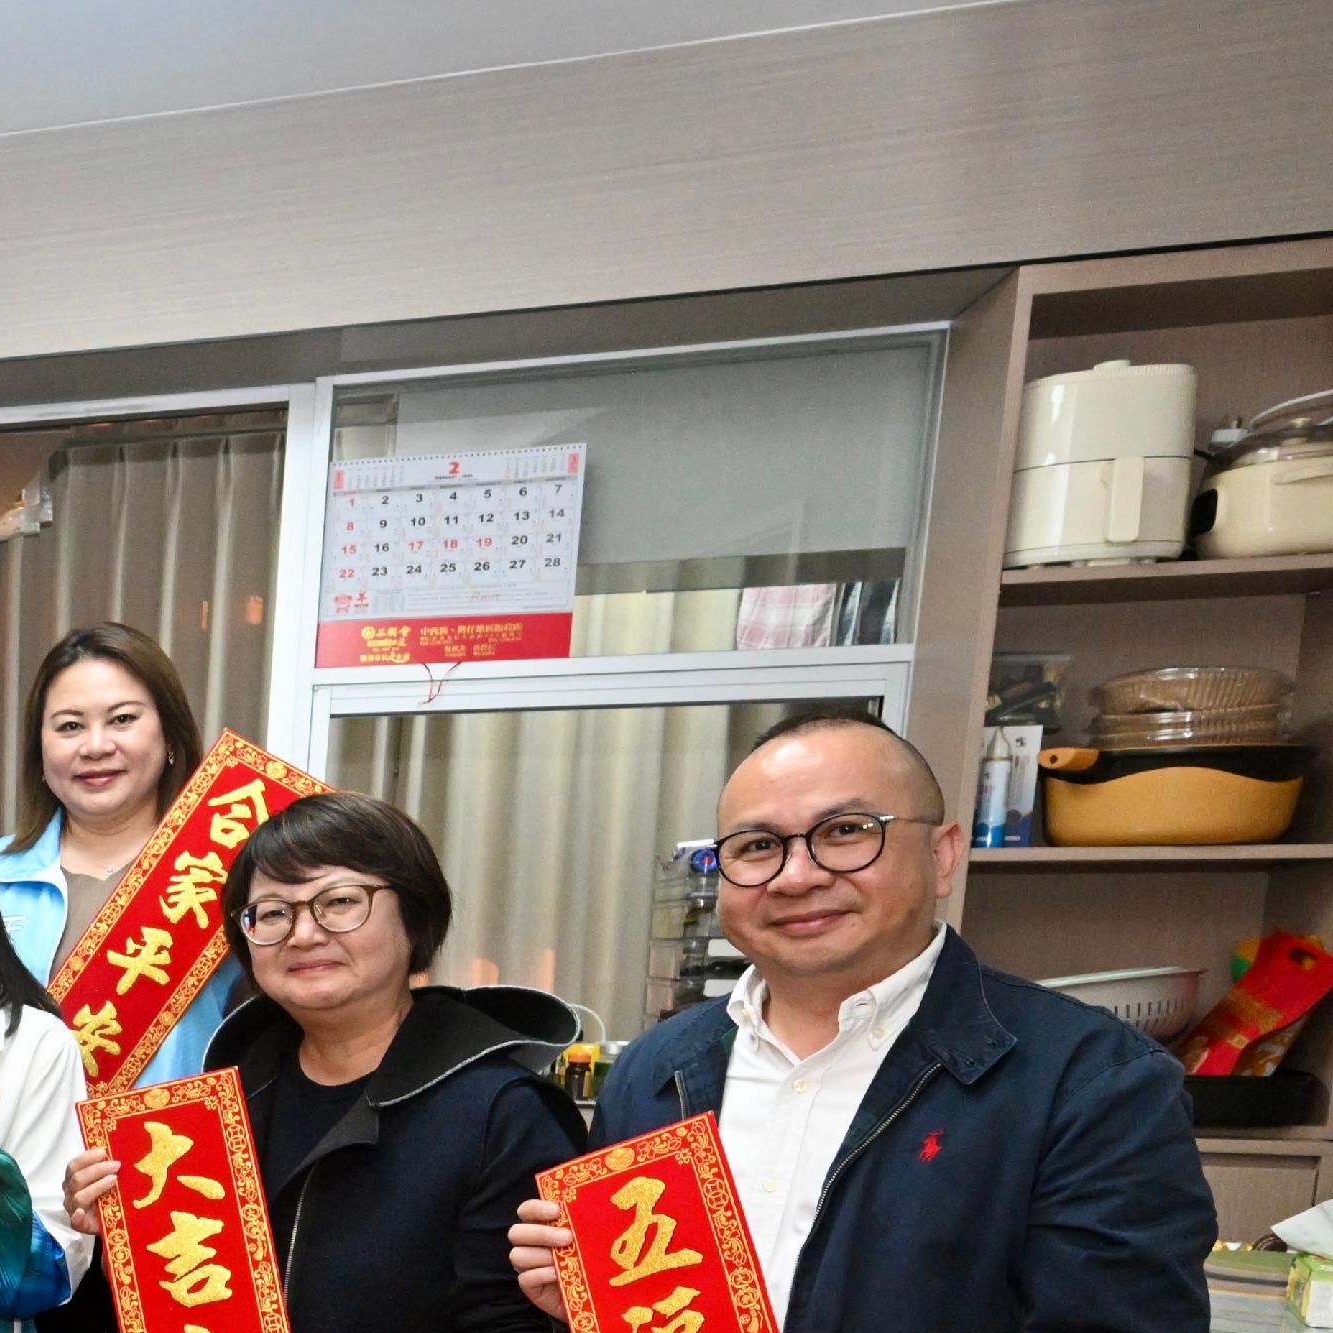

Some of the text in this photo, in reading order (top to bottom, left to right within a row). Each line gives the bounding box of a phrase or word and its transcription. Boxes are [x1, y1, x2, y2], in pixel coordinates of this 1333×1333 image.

[448, 461, 460, 475] 2
[349, 484, 562, 507] 1 2 3 4 5 6 7
[347, 508, 565, 531] 8 9 10 11 12 13 14
[341, 533, 561, 554] 15 16 17 18 19 20 21
[340, 558, 561, 578] 22 23 24 25 26 27 28
[72, 778, 270, 1077] 合家平安
